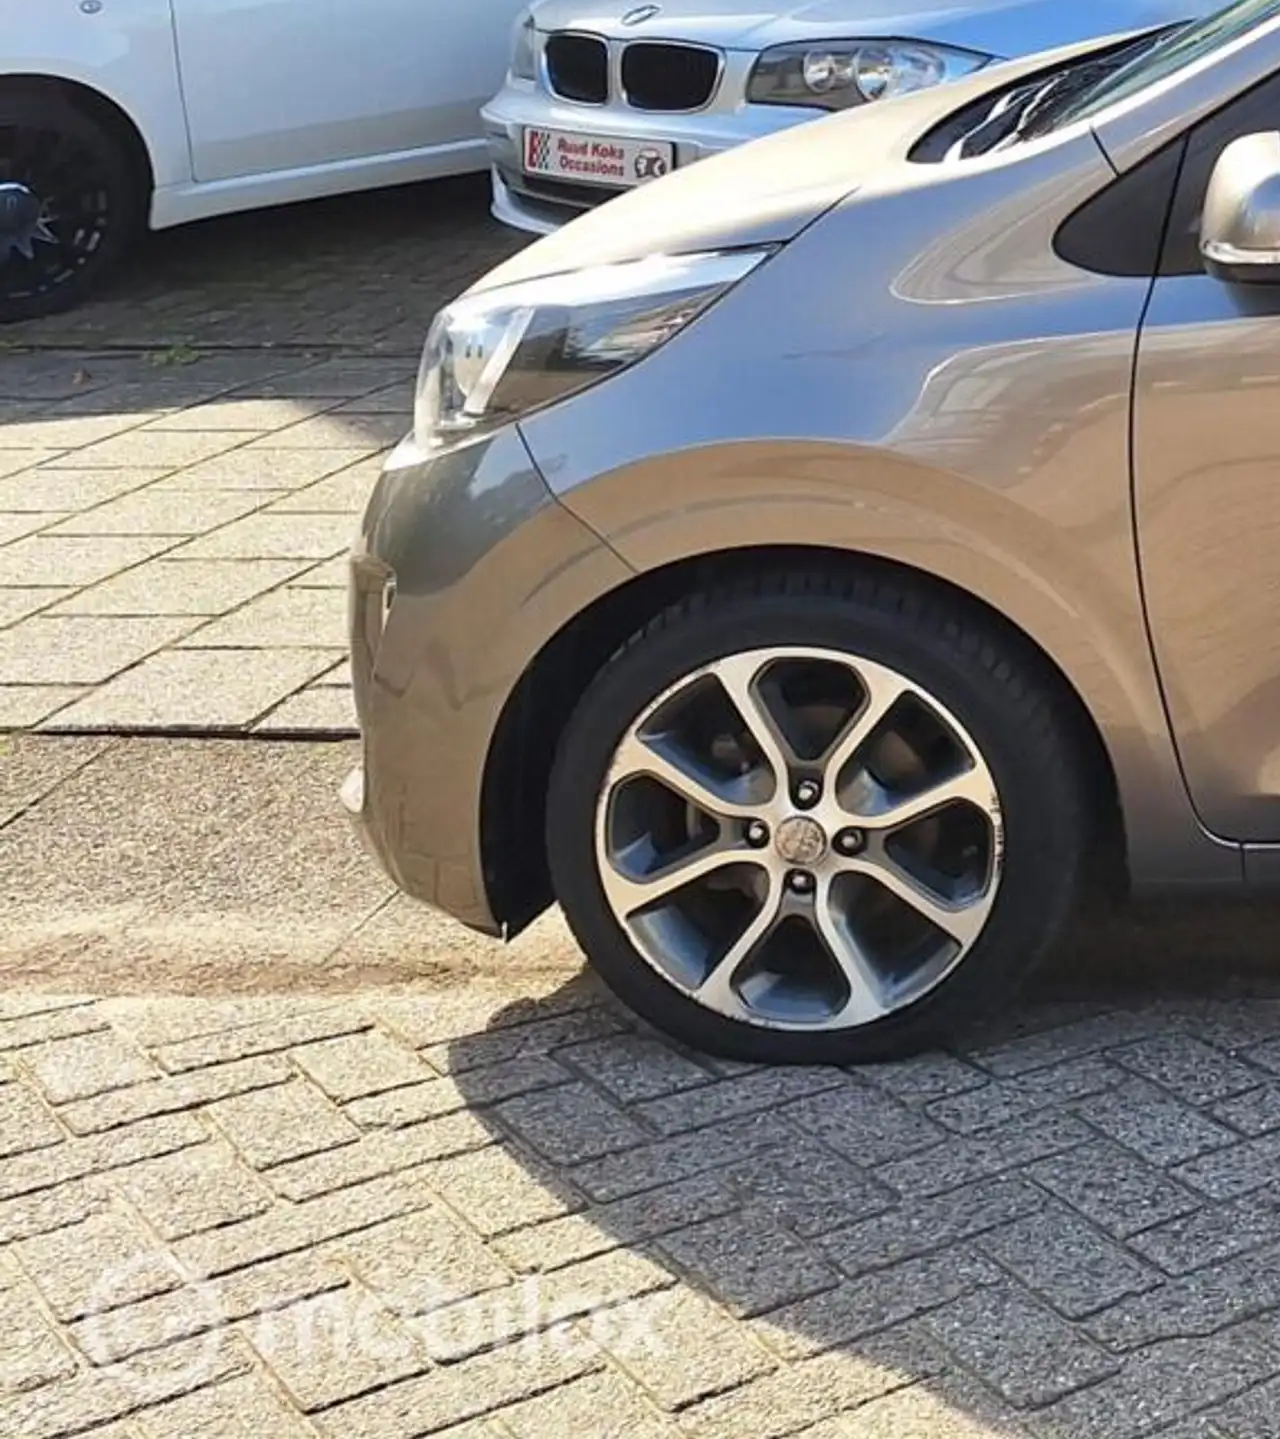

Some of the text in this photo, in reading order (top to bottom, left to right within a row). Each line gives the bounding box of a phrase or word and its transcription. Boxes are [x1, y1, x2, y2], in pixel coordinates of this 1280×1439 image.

[558, 137, 624, 160] Ruud Koks
[560, 155, 624, 177] Occasions
